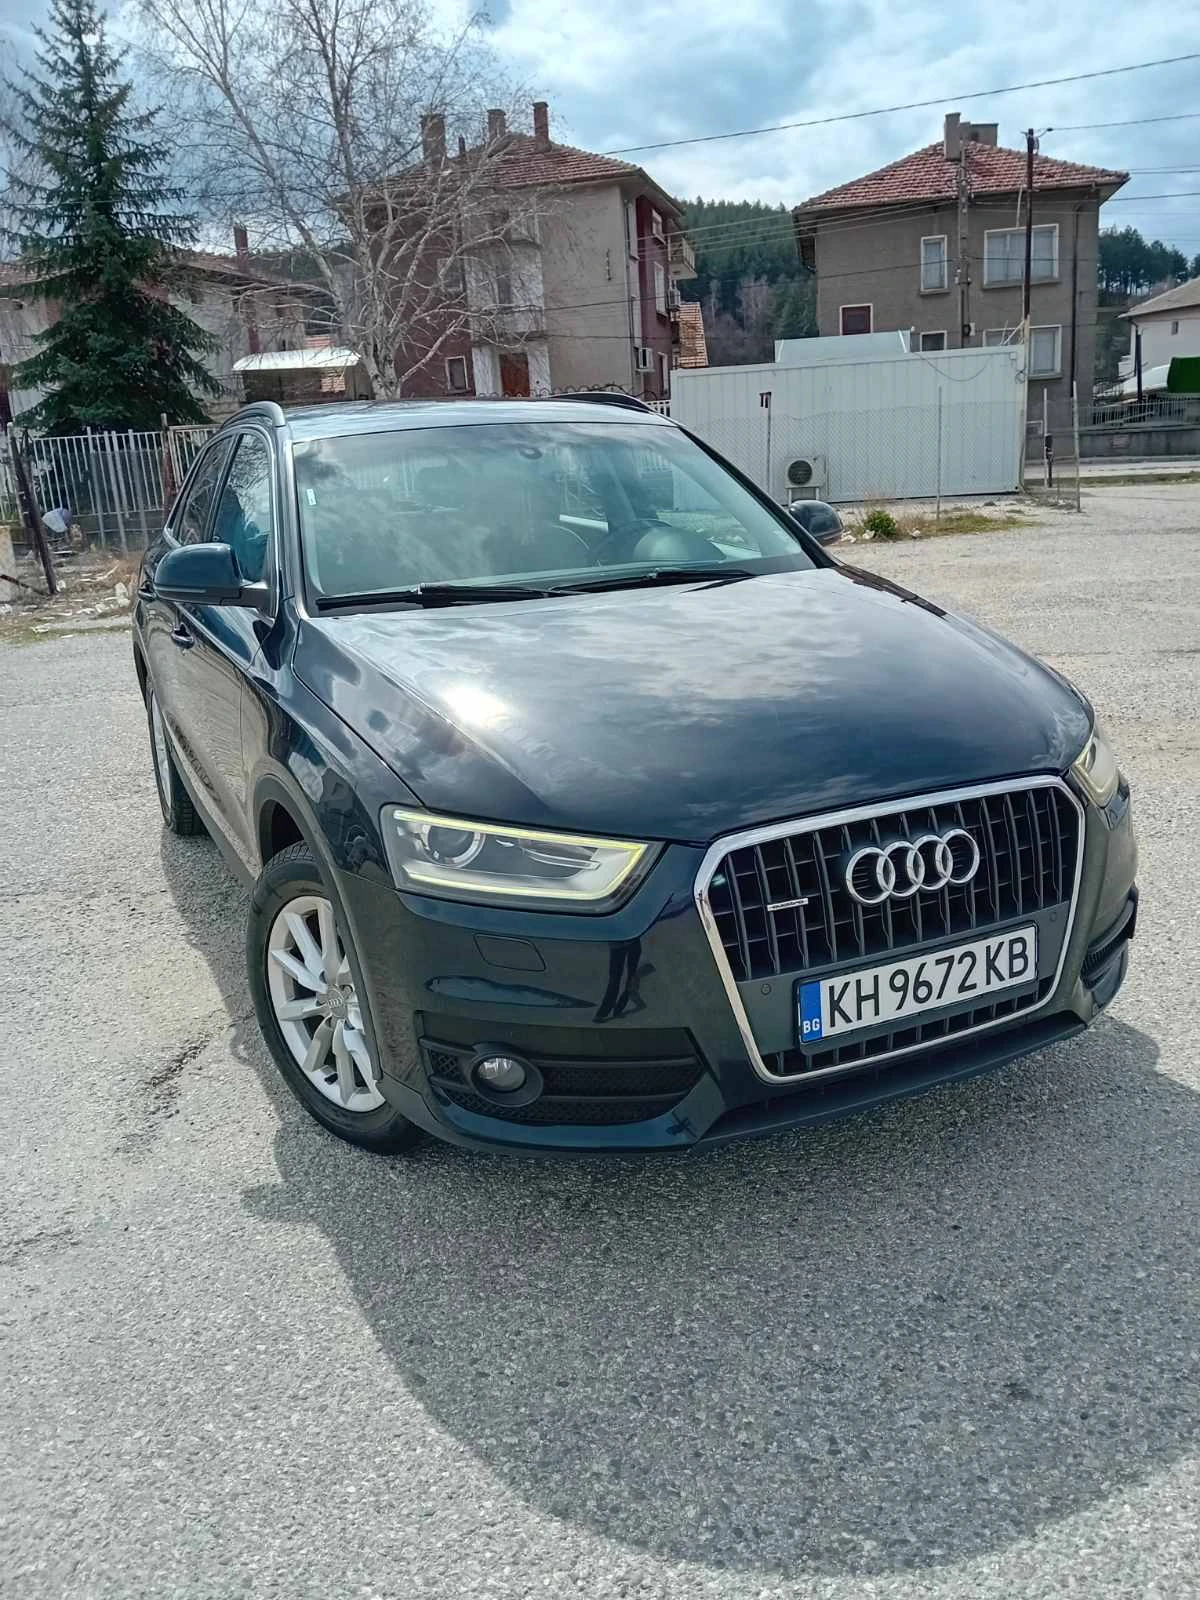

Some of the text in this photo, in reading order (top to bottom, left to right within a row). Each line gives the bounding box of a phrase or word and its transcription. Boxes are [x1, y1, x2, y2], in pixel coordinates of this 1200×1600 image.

[828, 936, 1029, 1028] KH 9672 KB
[803, 1018, 820, 1034] BG
